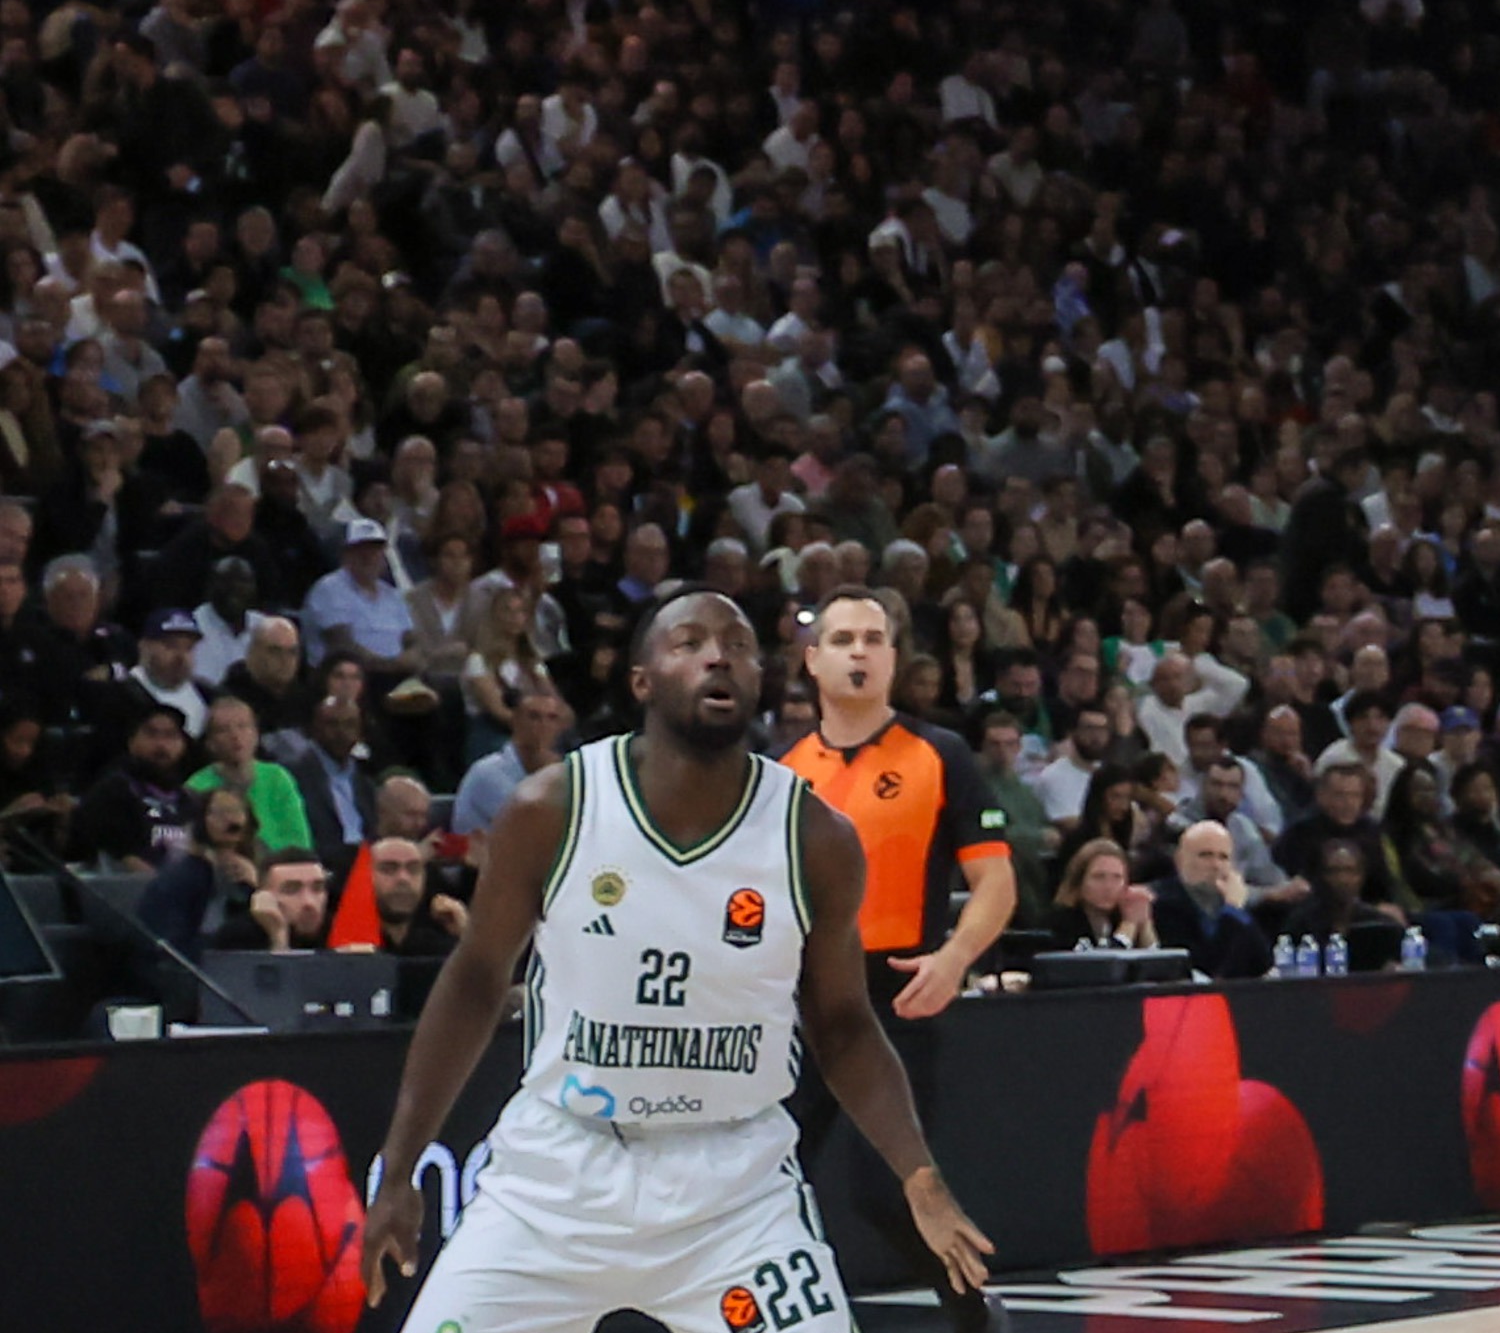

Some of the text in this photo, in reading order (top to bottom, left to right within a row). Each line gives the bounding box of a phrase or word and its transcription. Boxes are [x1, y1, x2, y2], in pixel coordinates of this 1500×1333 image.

[636, 947, 691, 1008] 22
[562, 1011, 763, 1076] PANATHINAIKOS
[755, 1249, 834, 1331] 22
